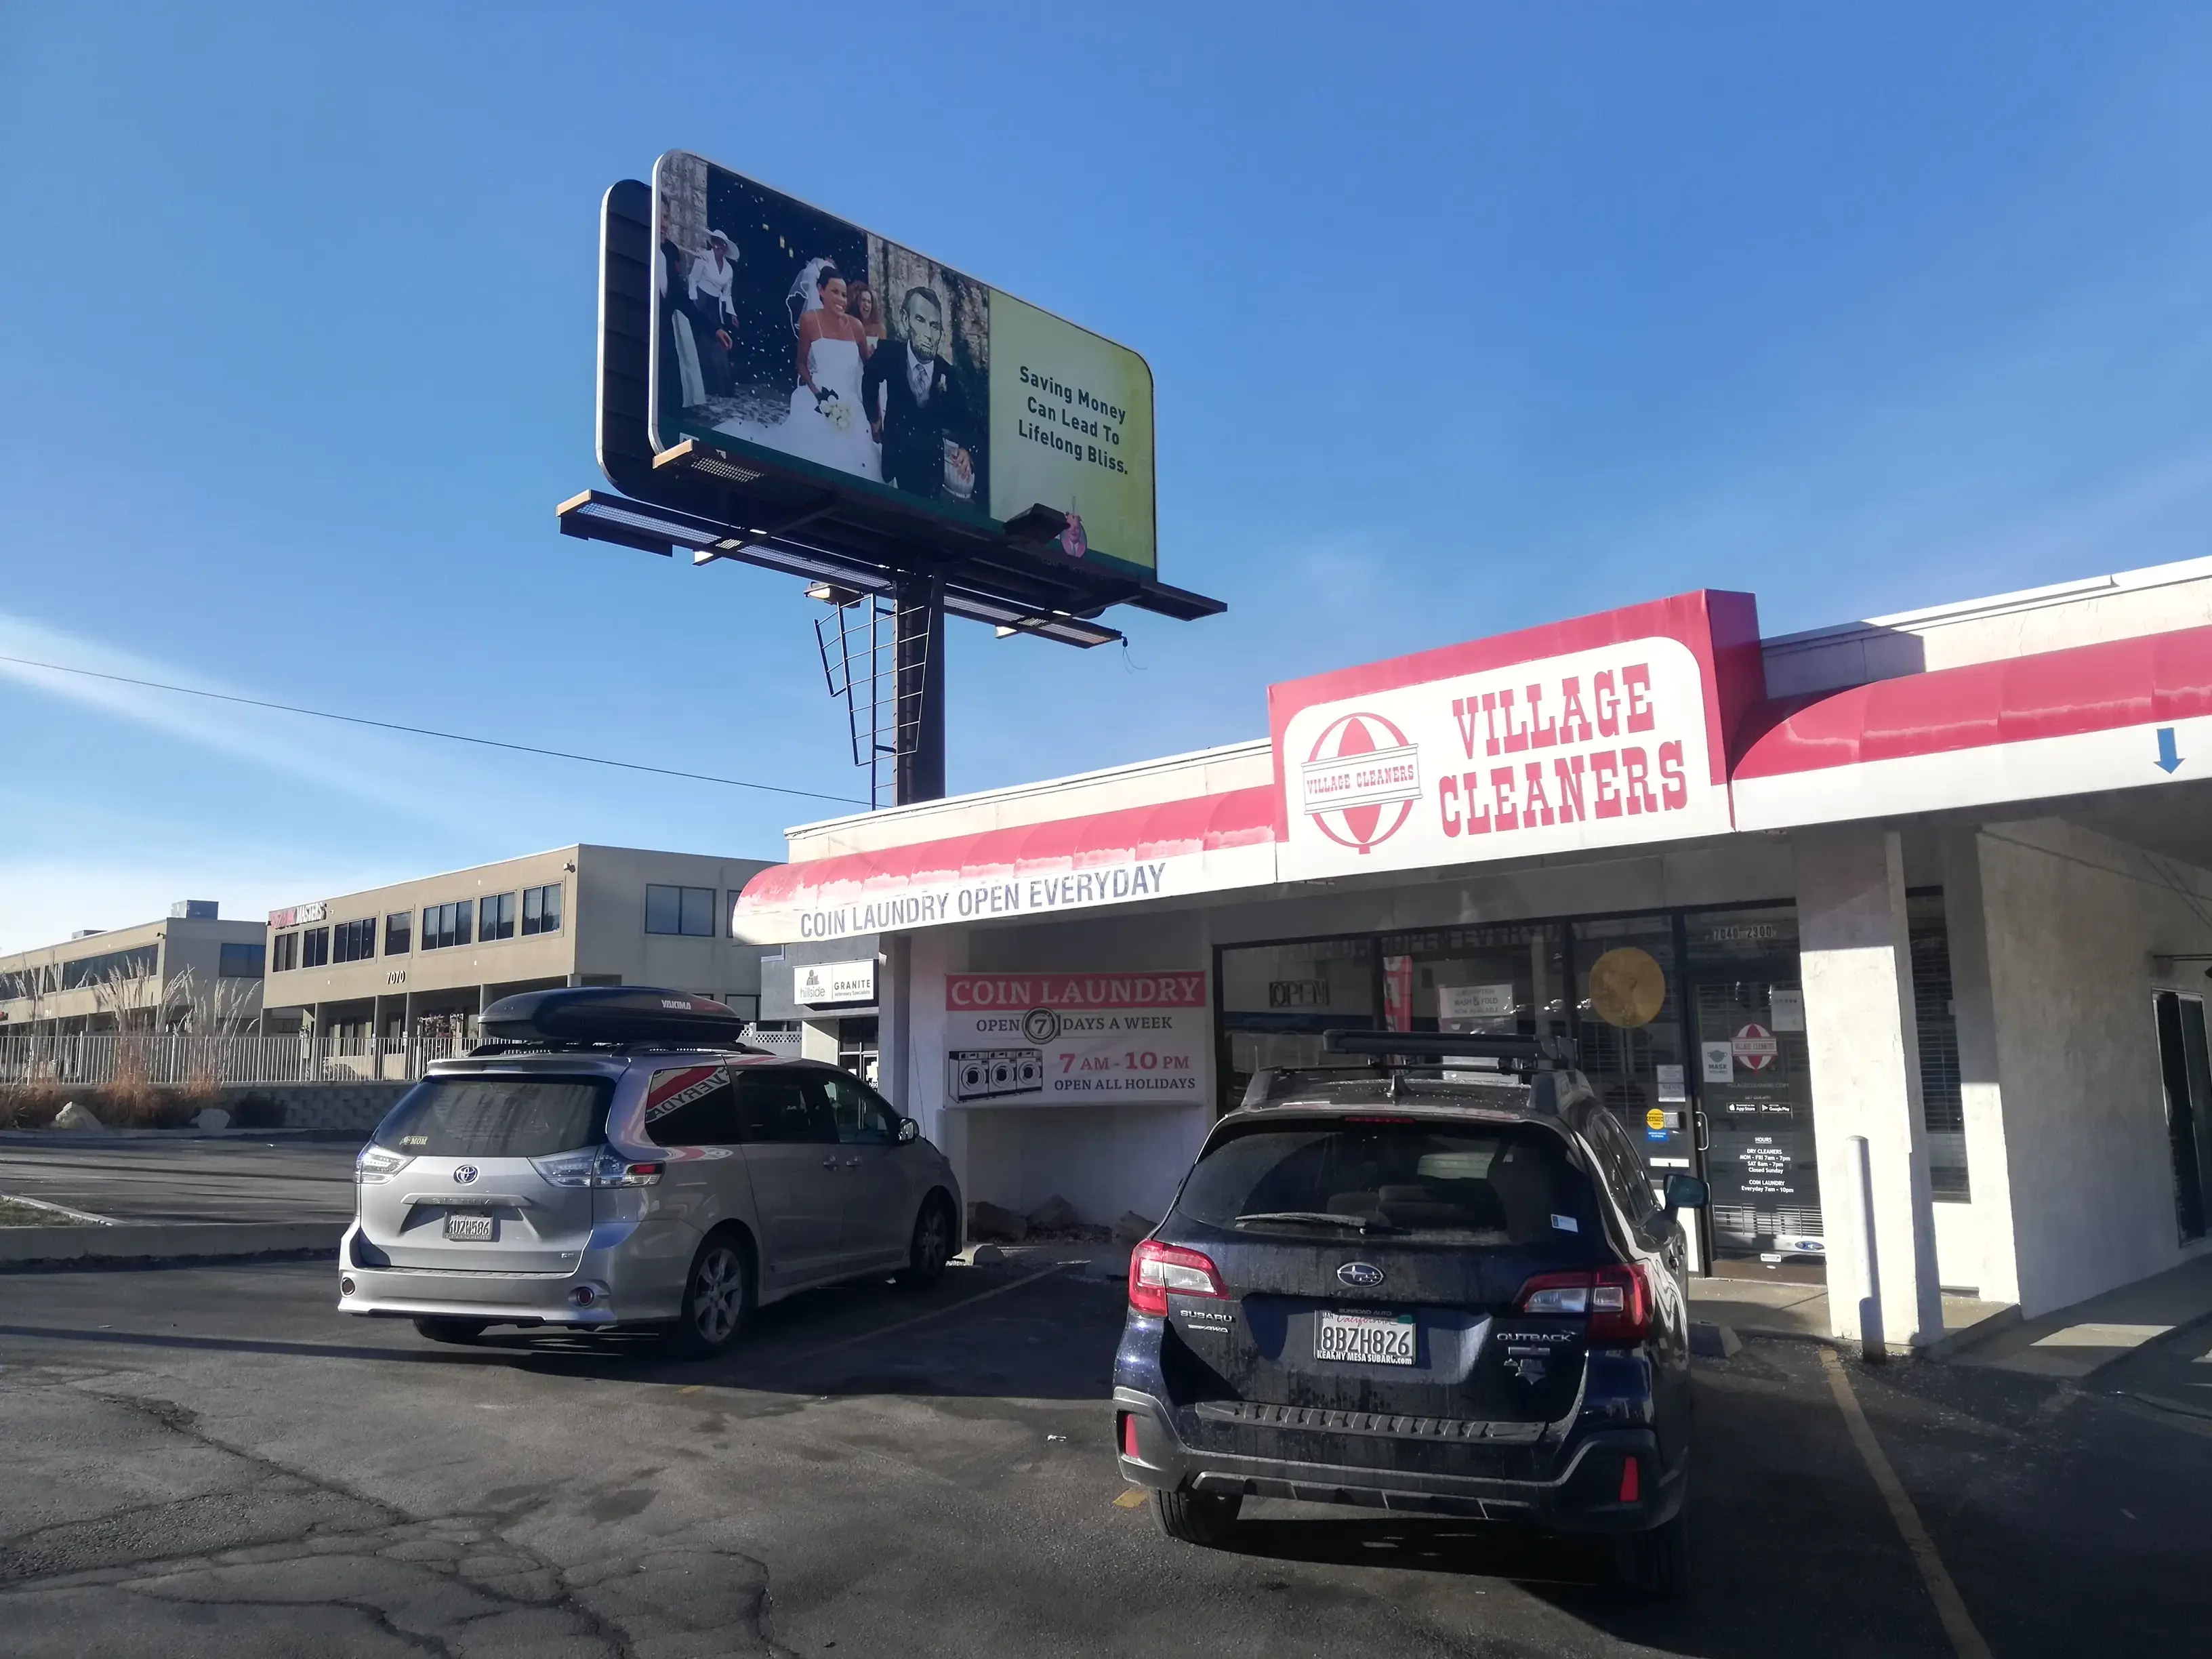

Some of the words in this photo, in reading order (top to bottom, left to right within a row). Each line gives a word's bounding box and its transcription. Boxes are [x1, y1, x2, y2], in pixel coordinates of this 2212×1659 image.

[1020, 366, 1072, 404] Saving
[1078, 388, 1126, 425] Money
[1027, 396, 1056, 422] Can
[1062, 409, 1097, 437] Lead
[1103, 424, 1120, 445] To
[1019, 419, 1082, 462] Lifelong
[1088, 445, 1128, 474] Bliss.
[1452, 663, 1655, 760] VILLAGE
[1307, 773, 1351, 794] VILLAGE
[1357, 764, 1414, 787] CLEANERS
[1439, 740, 1688, 838] CLEANERS
[800, 909, 846, 937] COIN
[853, 893, 949, 931] LAUNDRY
[958, 883, 1019, 916] OPEN
[1030, 863, 1166, 907] EVERYDAY
[296, 902, 325, 923] MASTERS
[1747, 926, 1772, 938] 2300
[387, 970, 406, 985] 7070
[834, 979, 871, 990] GRANITE
[800, 986, 825, 998] hillside
[951, 981, 1031, 1005] COIN
[1040, 977, 1200, 1004] LAUNDRY
[661, 1000, 691, 1010] YAKIMA
[977, 1019, 1021, 1031] OPEN
[1034, 1019, 1048, 1034] 7
[1063, 1016, 1105, 1030] DAYS
[1109, 1017, 1120, 1029] A
[1124, 1016, 1173, 1029] WEEK
[1059, 1053, 1076, 1073] 7
[1080, 1057, 1110, 1070] AM
[1125, 1052, 1158, 1069] 10
[1163, 1056, 1190, 1069] PM
[1054, 1080, 1091, 1090] OPEN
[1095, 1079, 1122, 1090] ALL
[1125, 1078, 1195, 1089] HOLIDAYS
[1180, 1310, 1233, 1322] SUBARU
[1322, 1326, 1410, 1356] 8BZH826
[1497, 1333, 1572, 1342] OUTBACK
[1317, 1350, 1346, 1360] KEARNY
[1347, 1352, 1366, 1361] MESA
